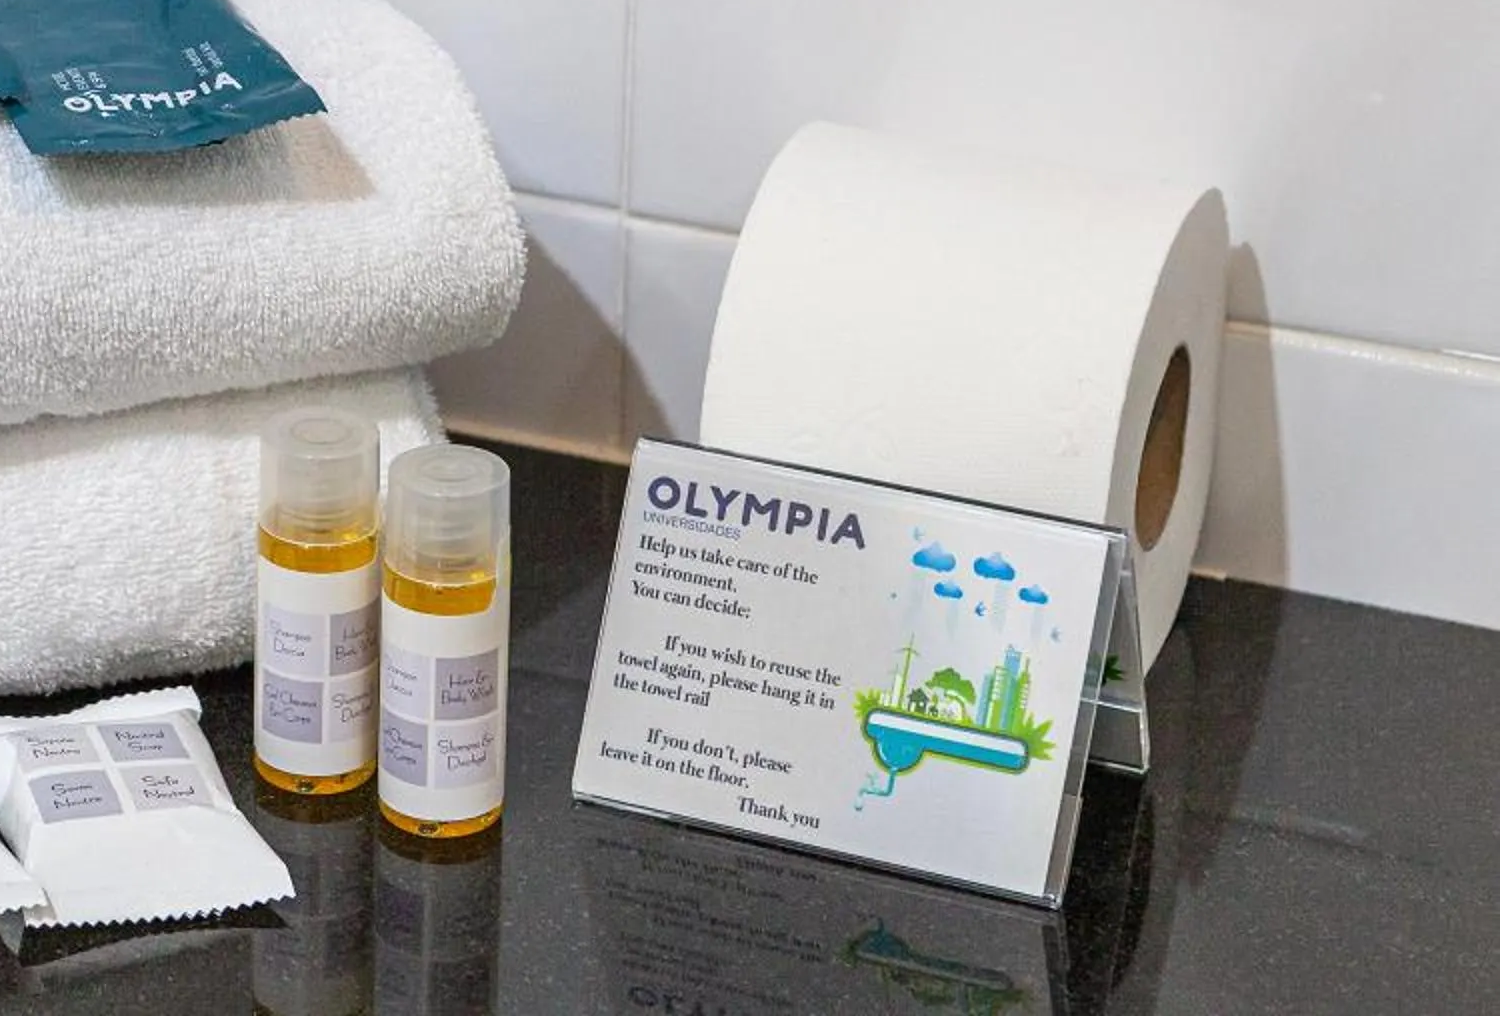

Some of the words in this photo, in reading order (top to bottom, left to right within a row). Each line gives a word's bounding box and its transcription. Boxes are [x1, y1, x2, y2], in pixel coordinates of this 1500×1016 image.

[63, 71, 243, 113] OLYMPIA
[643, 509, 742, 542] UNIVERSIDADES
[647, 475, 866, 551] OLYMPIA
[635, 559, 738, 593] environment.
[638, 534, 676, 558] Help
[679, 546, 698, 561] us
[701, 548, 735, 567] take
[737, 558, 769, 575] care
[773, 564, 791, 580] of
[792, 565, 819, 585] the
[631, 579, 660, 600] You
[663, 588, 691, 607] can
[618, 650, 658, 672] towel
[659, 662, 705, 683] again,
[709, 670, 759, 694] please
[761, 680, 801, 706] hang
[803, 690, 816, 706] it
[819, 692, 836, 710] in
[664, 635, 680, 652] If
[678, 642, 707, 658] you
[711, 647, 747, 667] wish
[750, 654, 766, 671] to
[769, 661, 812, 682] reuse
[815, 667, 841, 687] the
[613, 673, 639, 691] the
[641, 680, 683, 701] towel
[684, 690, 711, 707] rail
[600, 740, 640, 764] leave
[641, 751, 653, 766] it
[655, 758, 676, 773] on
[679, 760, 705, 779] the
[647, 728, 662, 744] If
[660, 735, 689, 751] you
[743, 751, 793, 774] please
[738, 794, 789, 822] Thank
[788, 811, 820, 830] you
